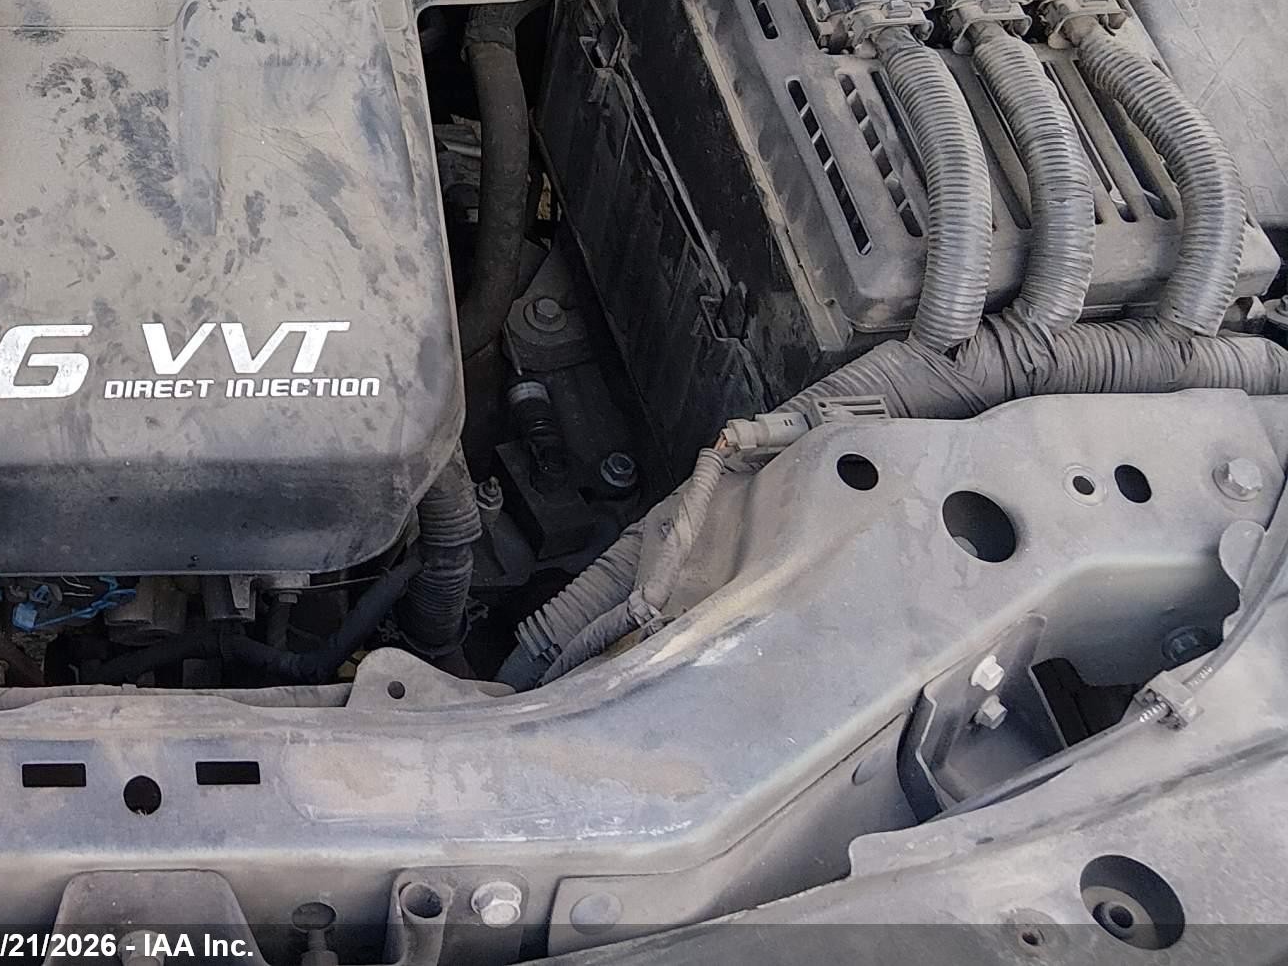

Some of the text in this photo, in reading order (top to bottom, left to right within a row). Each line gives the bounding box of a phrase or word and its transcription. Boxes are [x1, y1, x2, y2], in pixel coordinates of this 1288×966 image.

[141, 321, 351, 375] VVT
[104, 377, 380, 399] DIRECT INJECTION
